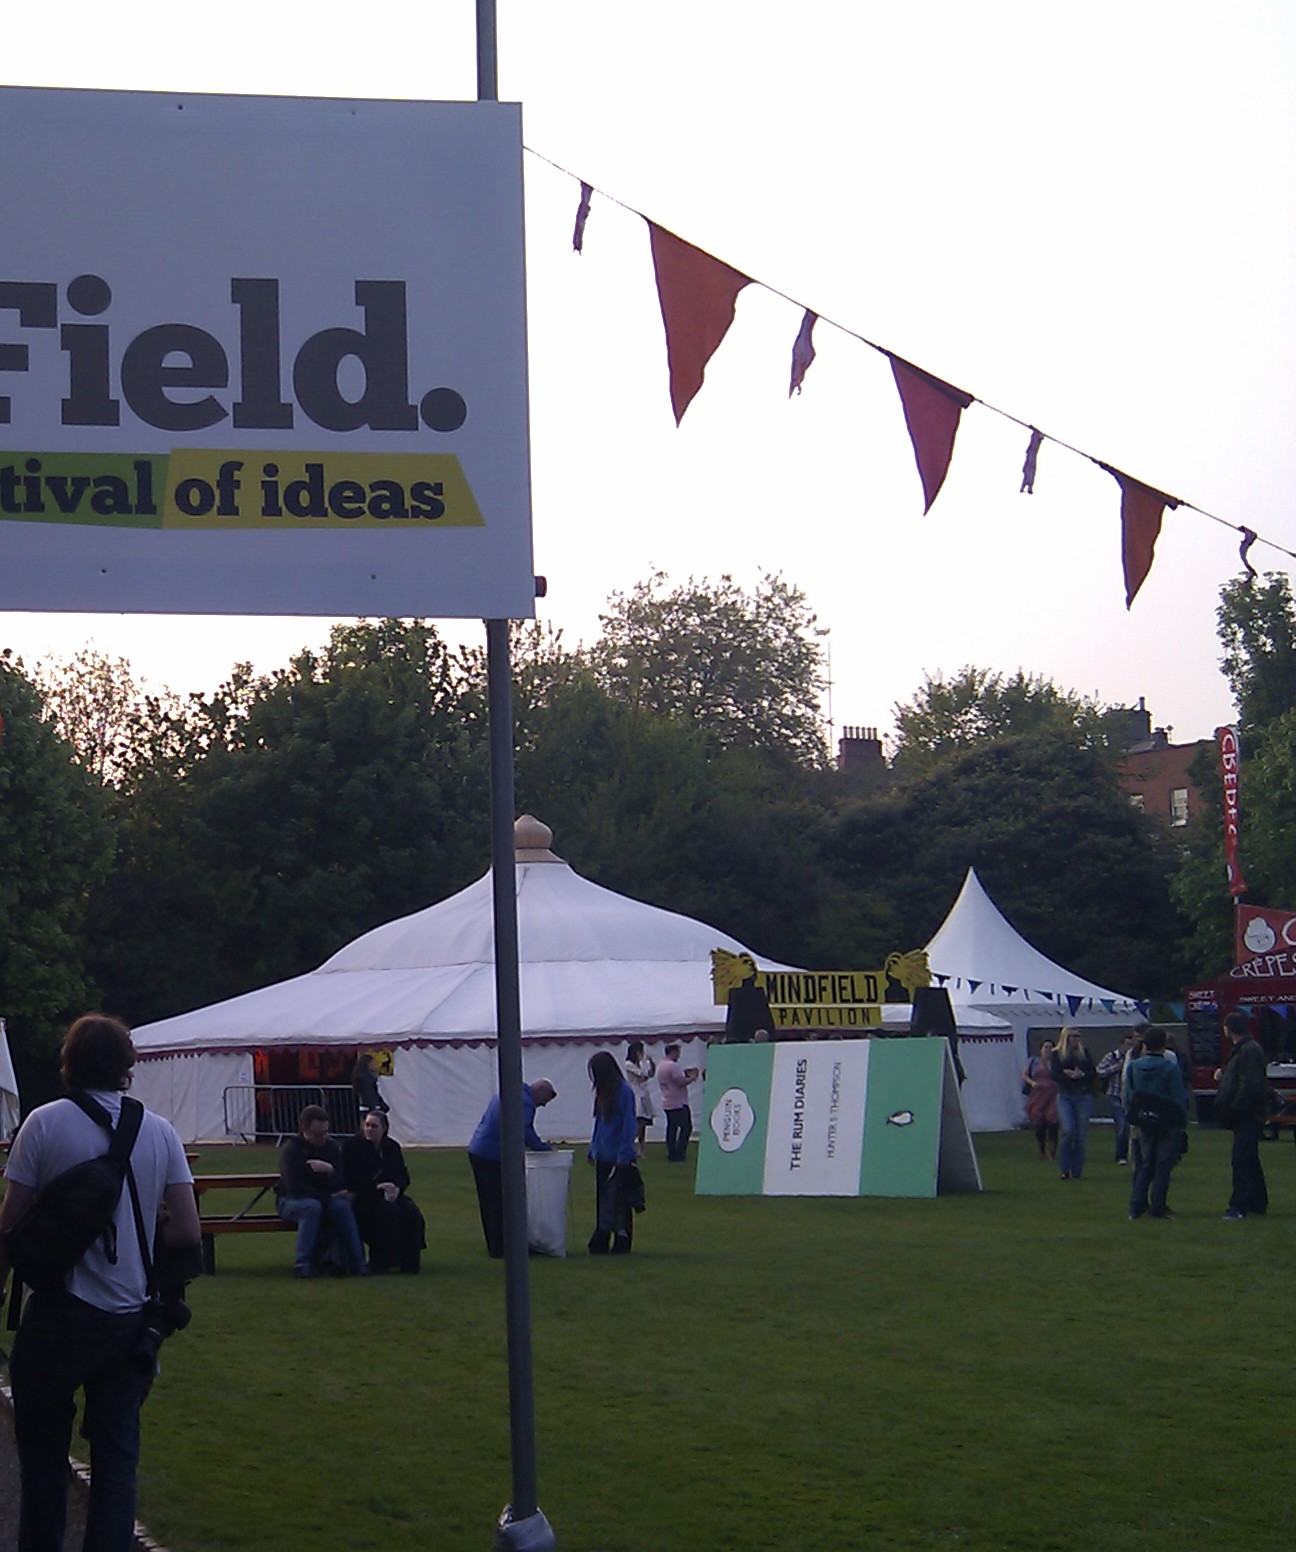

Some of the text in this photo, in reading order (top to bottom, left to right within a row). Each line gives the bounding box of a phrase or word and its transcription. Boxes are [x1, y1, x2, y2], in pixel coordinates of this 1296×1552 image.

[173, 460, 244, 517] of
[261, 462, 446, 521] ideas
[766, 974, 878, 1003] MINDFIELD
[778, 1008, 870, 1025] PAVILION
[830, 1062, 842, 1114] THOMPSON
[723, 1099, 732, 1142] PENGUIN
[732, 1104, 741, 1136] BOOKS
[790, 1059, 807, 1171] THE RUM DIARIES
[826, 1124, 837, 1158] HUNTER
